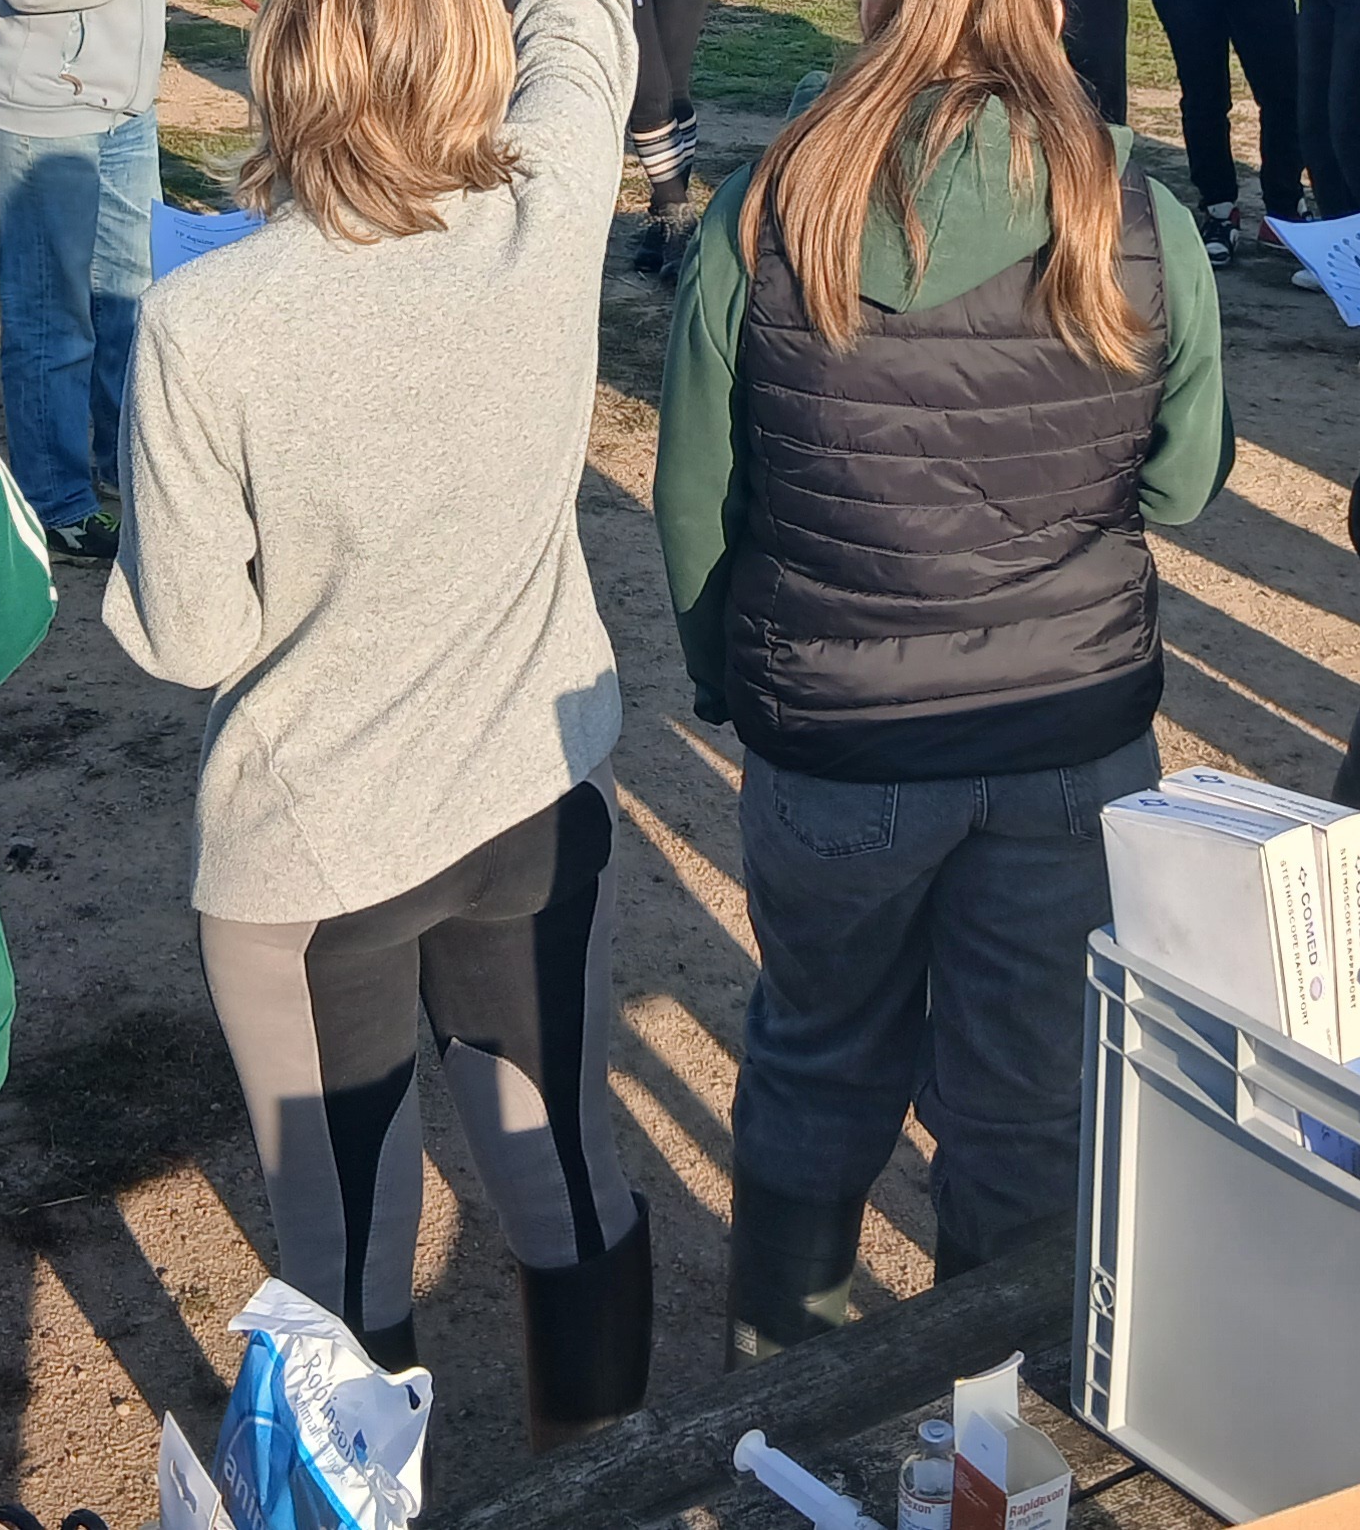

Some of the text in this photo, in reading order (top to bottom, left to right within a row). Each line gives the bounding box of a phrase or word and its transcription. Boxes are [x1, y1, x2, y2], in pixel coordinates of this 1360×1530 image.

[1300, 891, 1319, 966] COMED
[1294, 952, 1310, 1027] RAPPAPORT
[1347, 937, 1357, 1010] RAPPAPORT
[302, 1352, 356, 1464] Robinson
